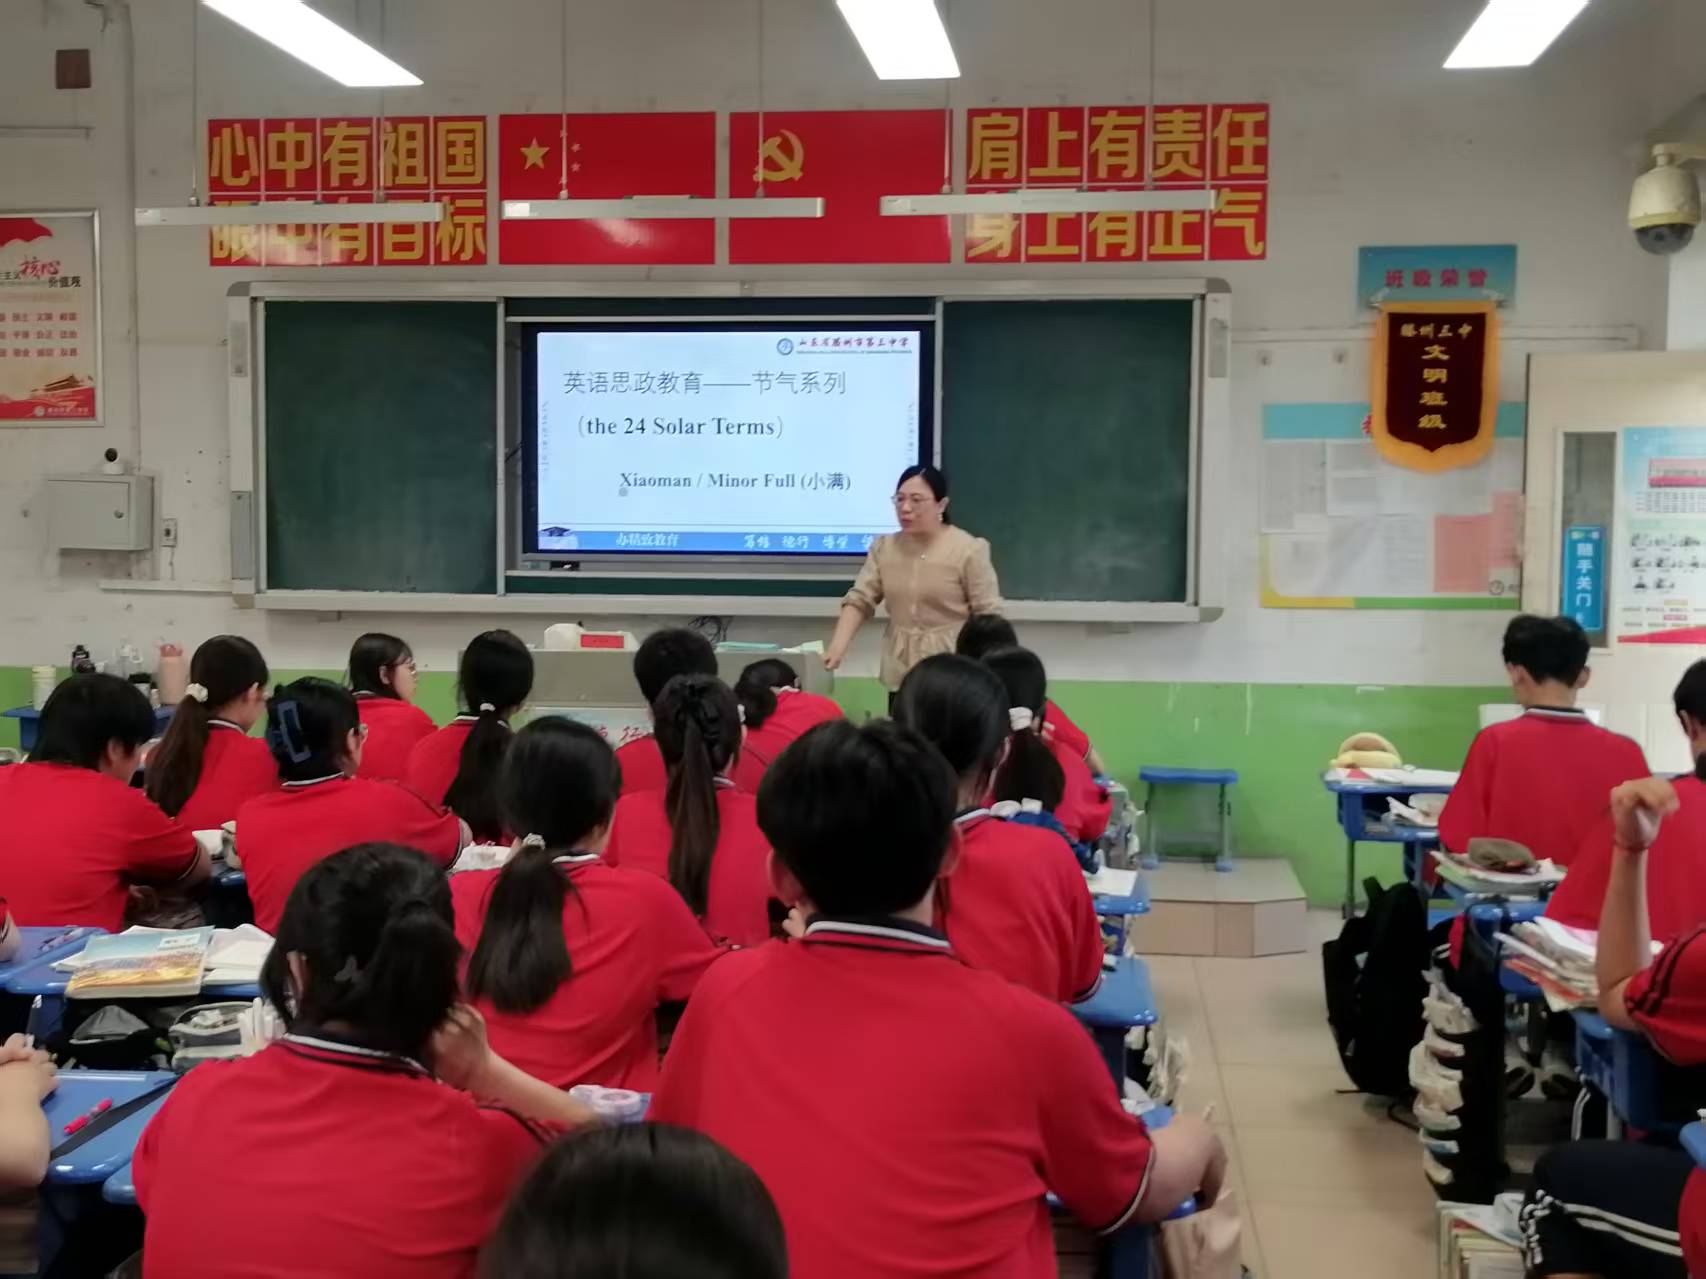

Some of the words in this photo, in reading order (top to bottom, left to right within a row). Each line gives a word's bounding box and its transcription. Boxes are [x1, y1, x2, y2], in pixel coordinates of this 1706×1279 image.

[210, 121, 485, 188] 心中有祖国
[968, 109, 1267, 179] 肩上有责任
[1418, 344, 1450, 429] 文明班级
[623, 417, 646, 435] 24
[652, 417, 706, 436] Solar
[619, 472, 692, 488] Xiaoman
[708, 472, 758, 488] Minor
[763, 472, 796, 488] Full
[800, 472, 852, 490] (小满)
